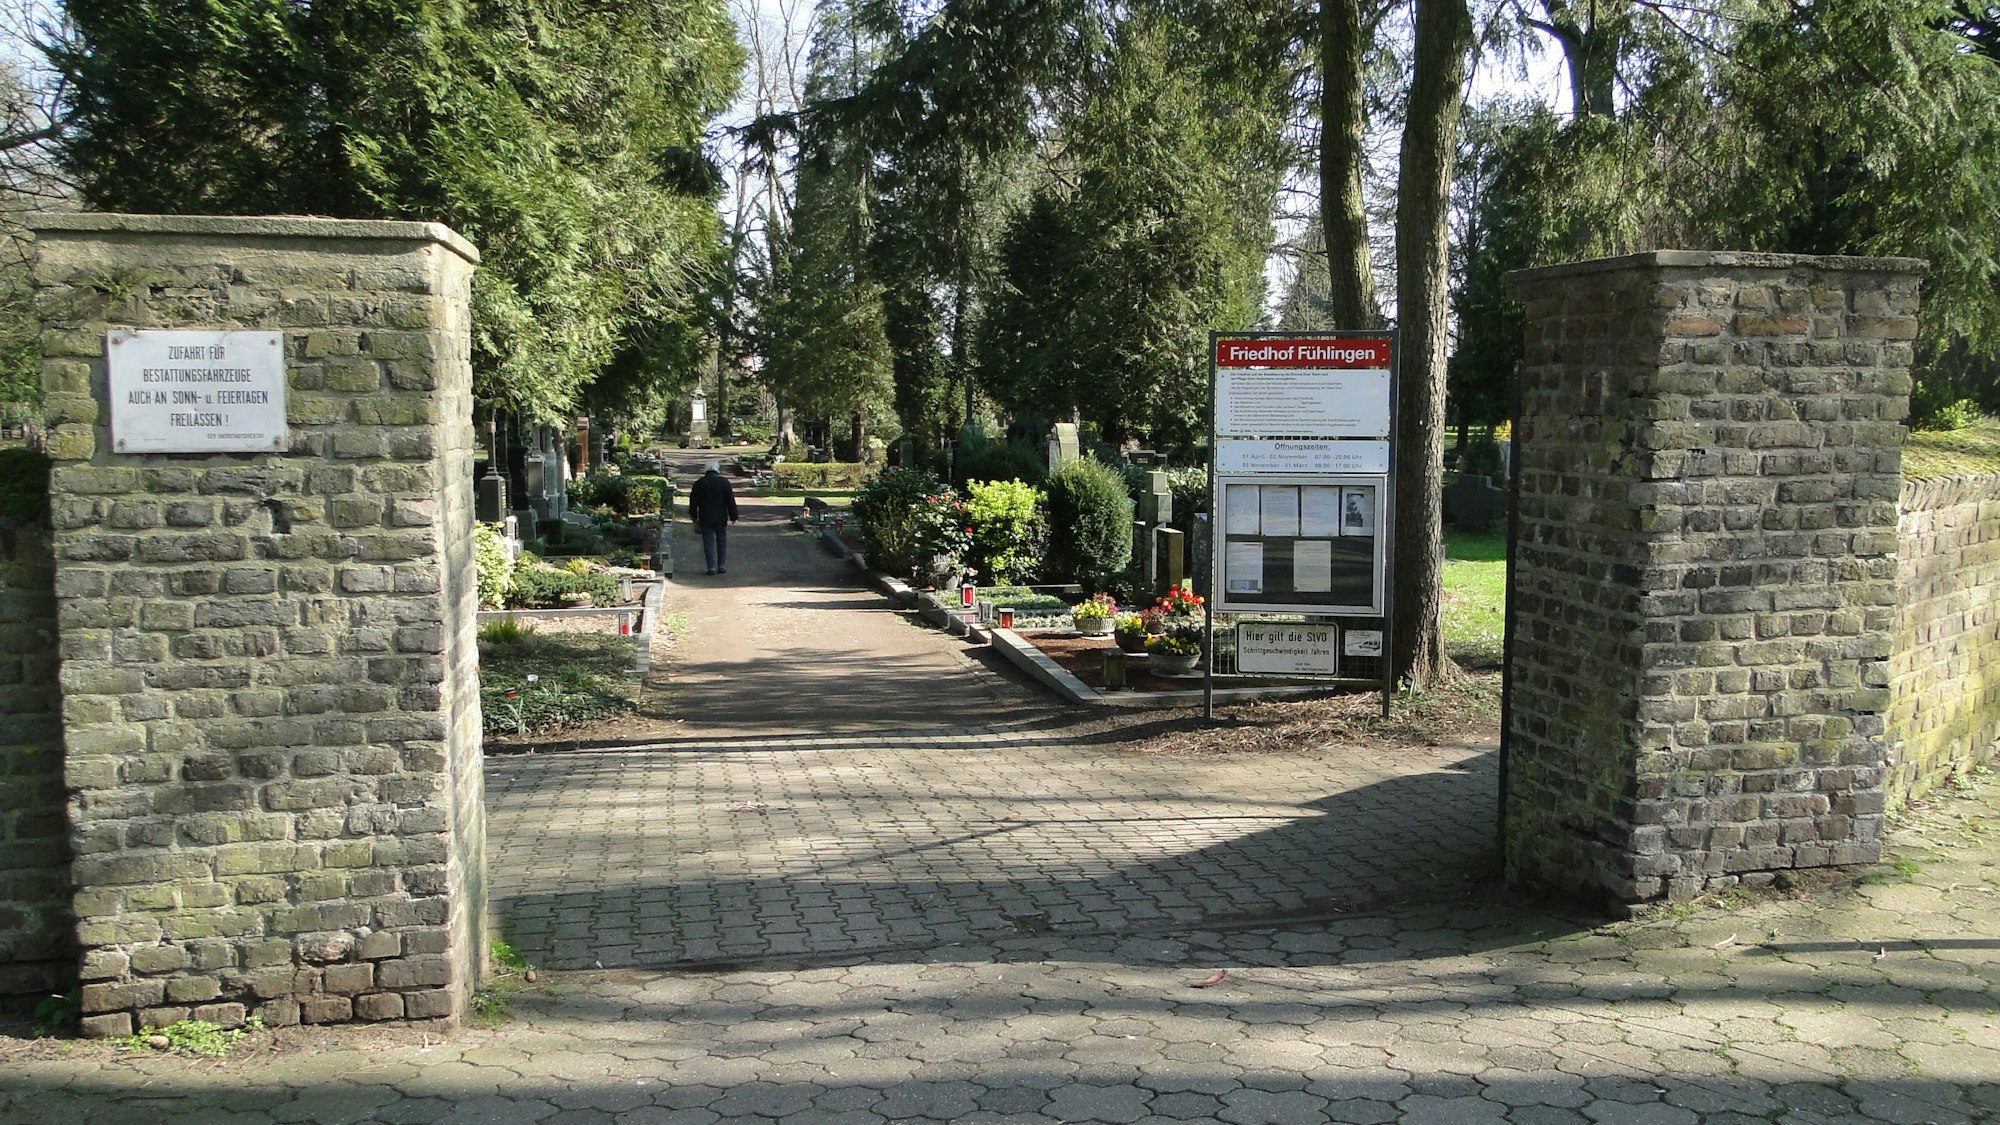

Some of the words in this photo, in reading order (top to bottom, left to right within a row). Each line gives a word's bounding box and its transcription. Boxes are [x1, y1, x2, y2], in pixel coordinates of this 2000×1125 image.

[168, 346, 205, 360] ZUFAHRT
[209, 344, 225, 360] FÜR
[1230, 346, 1295, 361] Friedhof
[1298, 346, 1375, 363] Fühlingen
[143, 368, 252, 383] BESTATTUNGSFAHRZEUGE
[128, 391, 152, 405] AUCH
[155, 391, 167, 405] AN
[173, 391, 202, 405] SONN-
[217, 391, 269, 405] FEIERTAGEN
[170, 413, 222, 427] FREILASSEN
[1246, 631, 1264, 641] Hier
[1268, 631, 1284, 644] gilt
[1288, 631, 1302, 642] die
[1306, 632, 1327, 642] StVO
[1243, 647, 1309, 656] Schrittgeschwindigkeit
[1311, 647, 1330, 655] fahren
